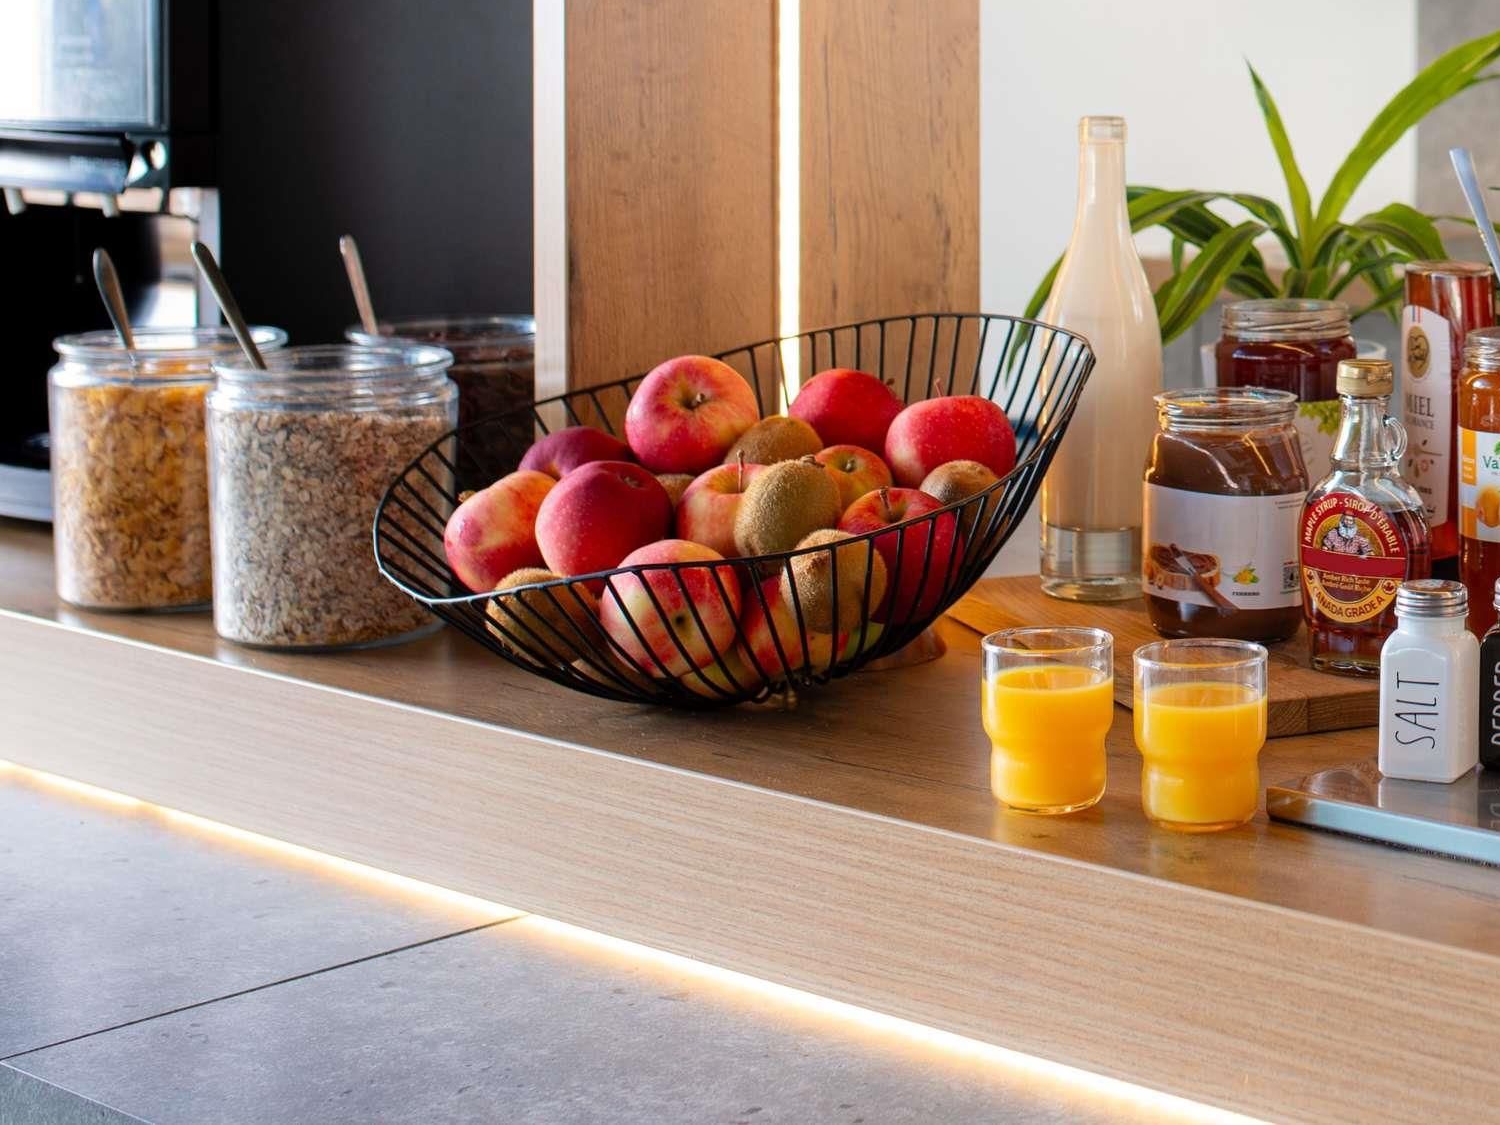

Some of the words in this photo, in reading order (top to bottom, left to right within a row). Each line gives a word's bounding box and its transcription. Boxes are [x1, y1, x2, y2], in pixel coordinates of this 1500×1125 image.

[1304, 512, 1318, 542] MAPLE
[1317, 498, 1338, 515] SYRUP
[1312, 587, 1344, 616] CANADA
[1345, 600, 1379, 618] GRADE
[1376, 595, 1386, 606] A
[1395, 671, 1440, 749] SALT
